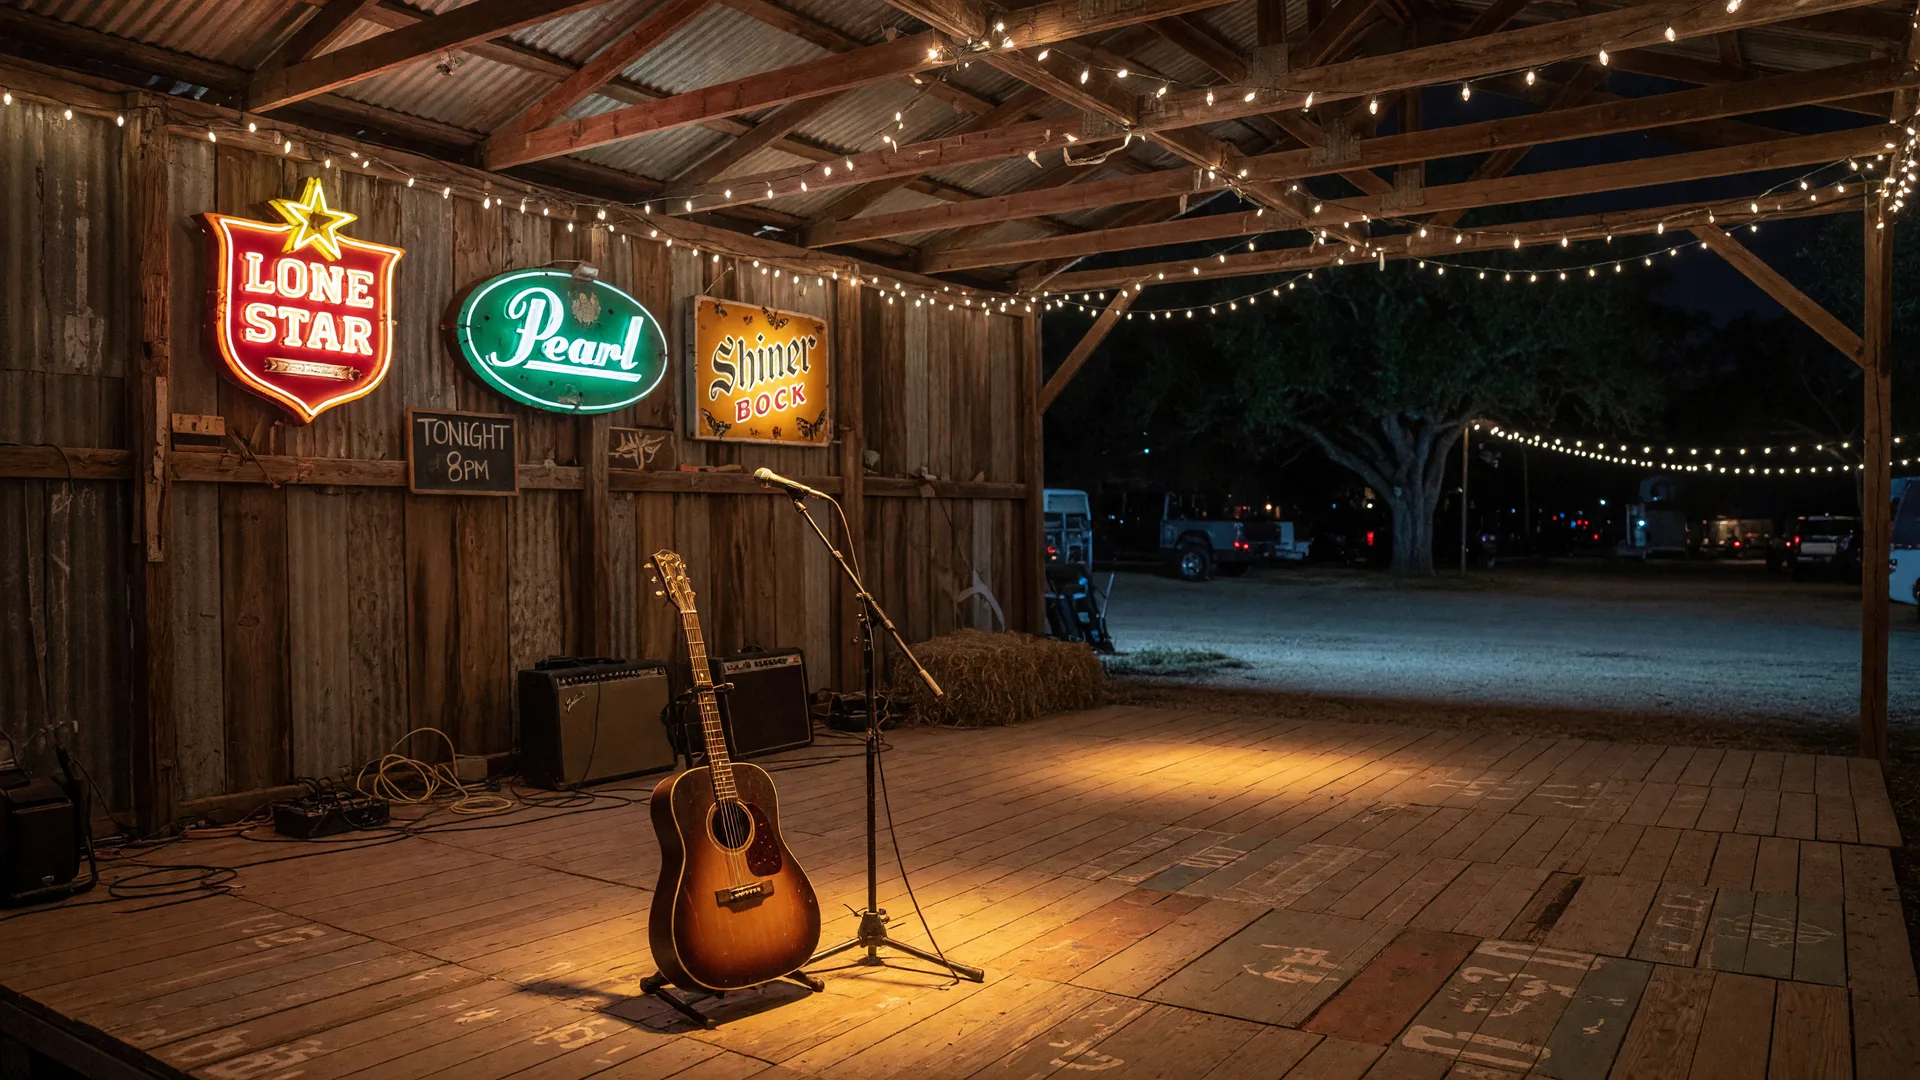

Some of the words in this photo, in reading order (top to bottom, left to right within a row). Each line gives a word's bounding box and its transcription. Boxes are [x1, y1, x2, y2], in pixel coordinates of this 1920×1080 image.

[244, 252, 374, 309] LONE
[244, 302, 374, 356] STAR
[489, 287, 644, 371] Pearl
[709, 333, 817, 401] Shiner
[736, 382, 807, 423] BOCK
[416, 418, 511, 450] TONIGHT
